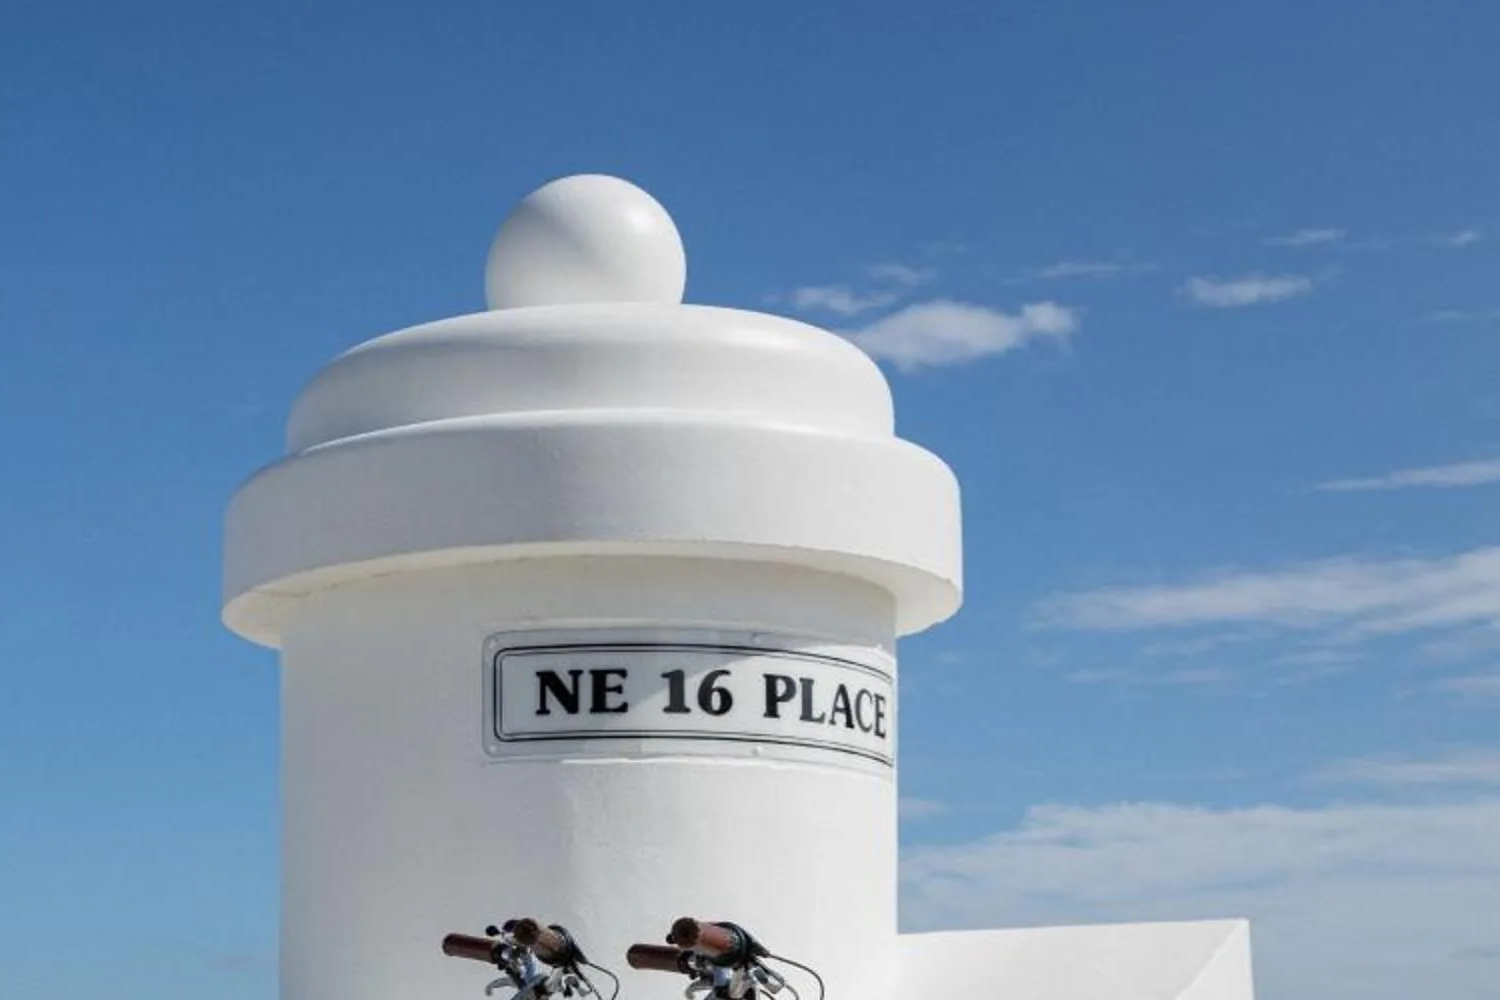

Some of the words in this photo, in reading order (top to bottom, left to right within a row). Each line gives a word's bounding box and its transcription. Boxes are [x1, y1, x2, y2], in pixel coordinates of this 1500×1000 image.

[535, 668, 628, 716] NE
[660, 668, 733, 715] 16
[762, 673, 887, 739] PLACE
